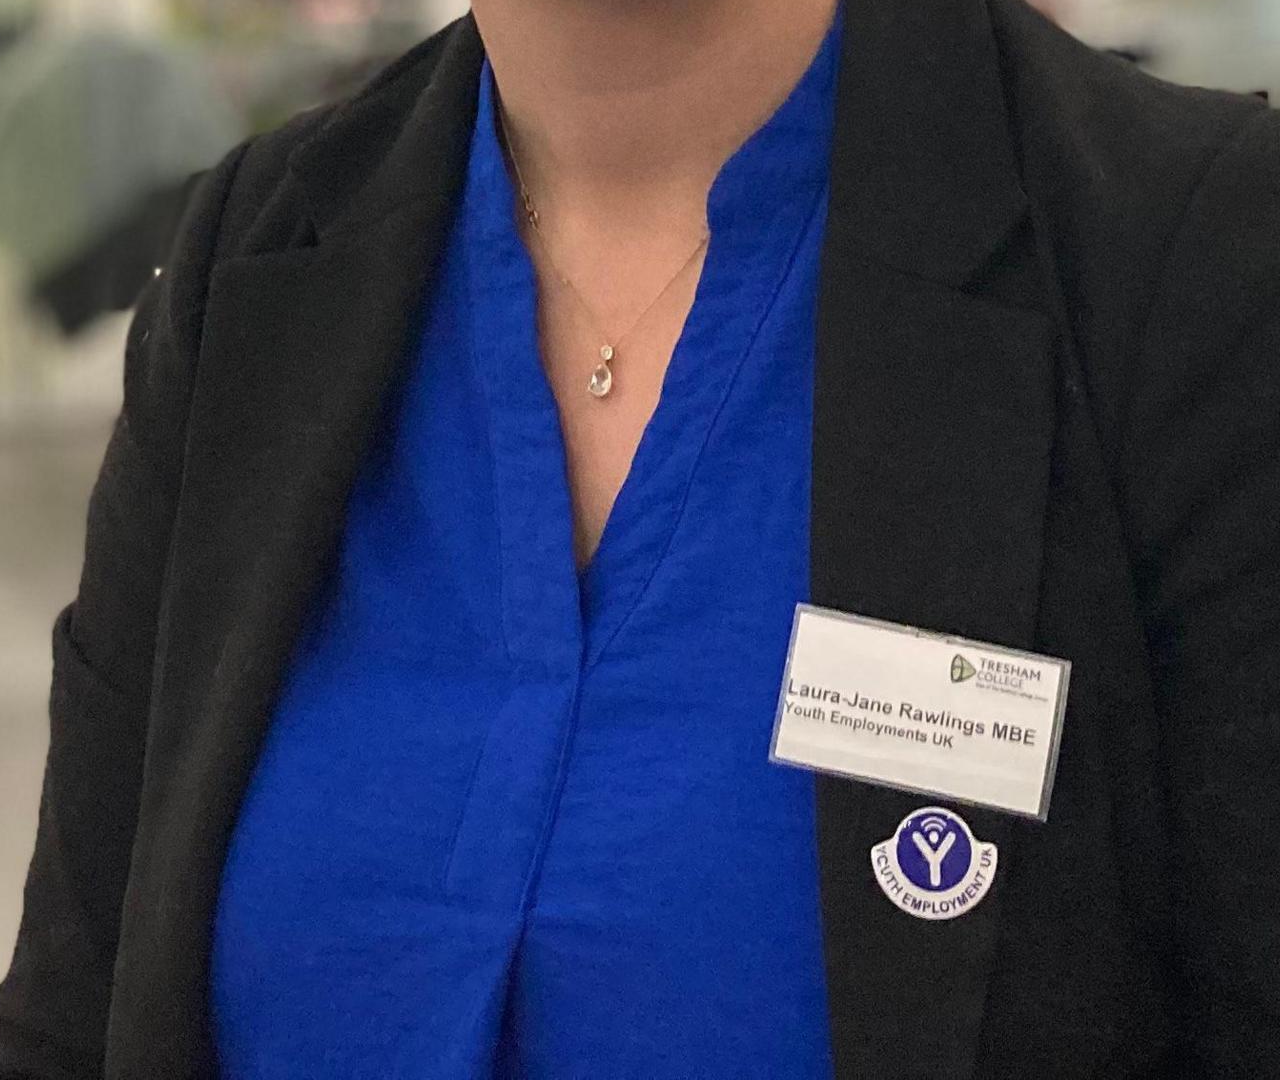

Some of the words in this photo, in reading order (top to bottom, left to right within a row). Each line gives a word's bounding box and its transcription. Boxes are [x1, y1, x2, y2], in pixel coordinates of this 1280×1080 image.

[977, 670, 1023, 689] COLLEGE
[980, 657, 1041, 681] TRESHAM
[785, 700, 826, 724] Youth
[830, 710, 927, 743] Employments
[932, 732, 954, 749] UK
[788, 678, 893, 715] Laura-Jane
[899, 701, 985, 736] Rawlings
[992, 721, 1037, 746] MBE
[876, 845, 904, 895] YOUTH
[902, 870, 986, 914] EMPLOYMENT
[981, 847, 994, 868] UK
